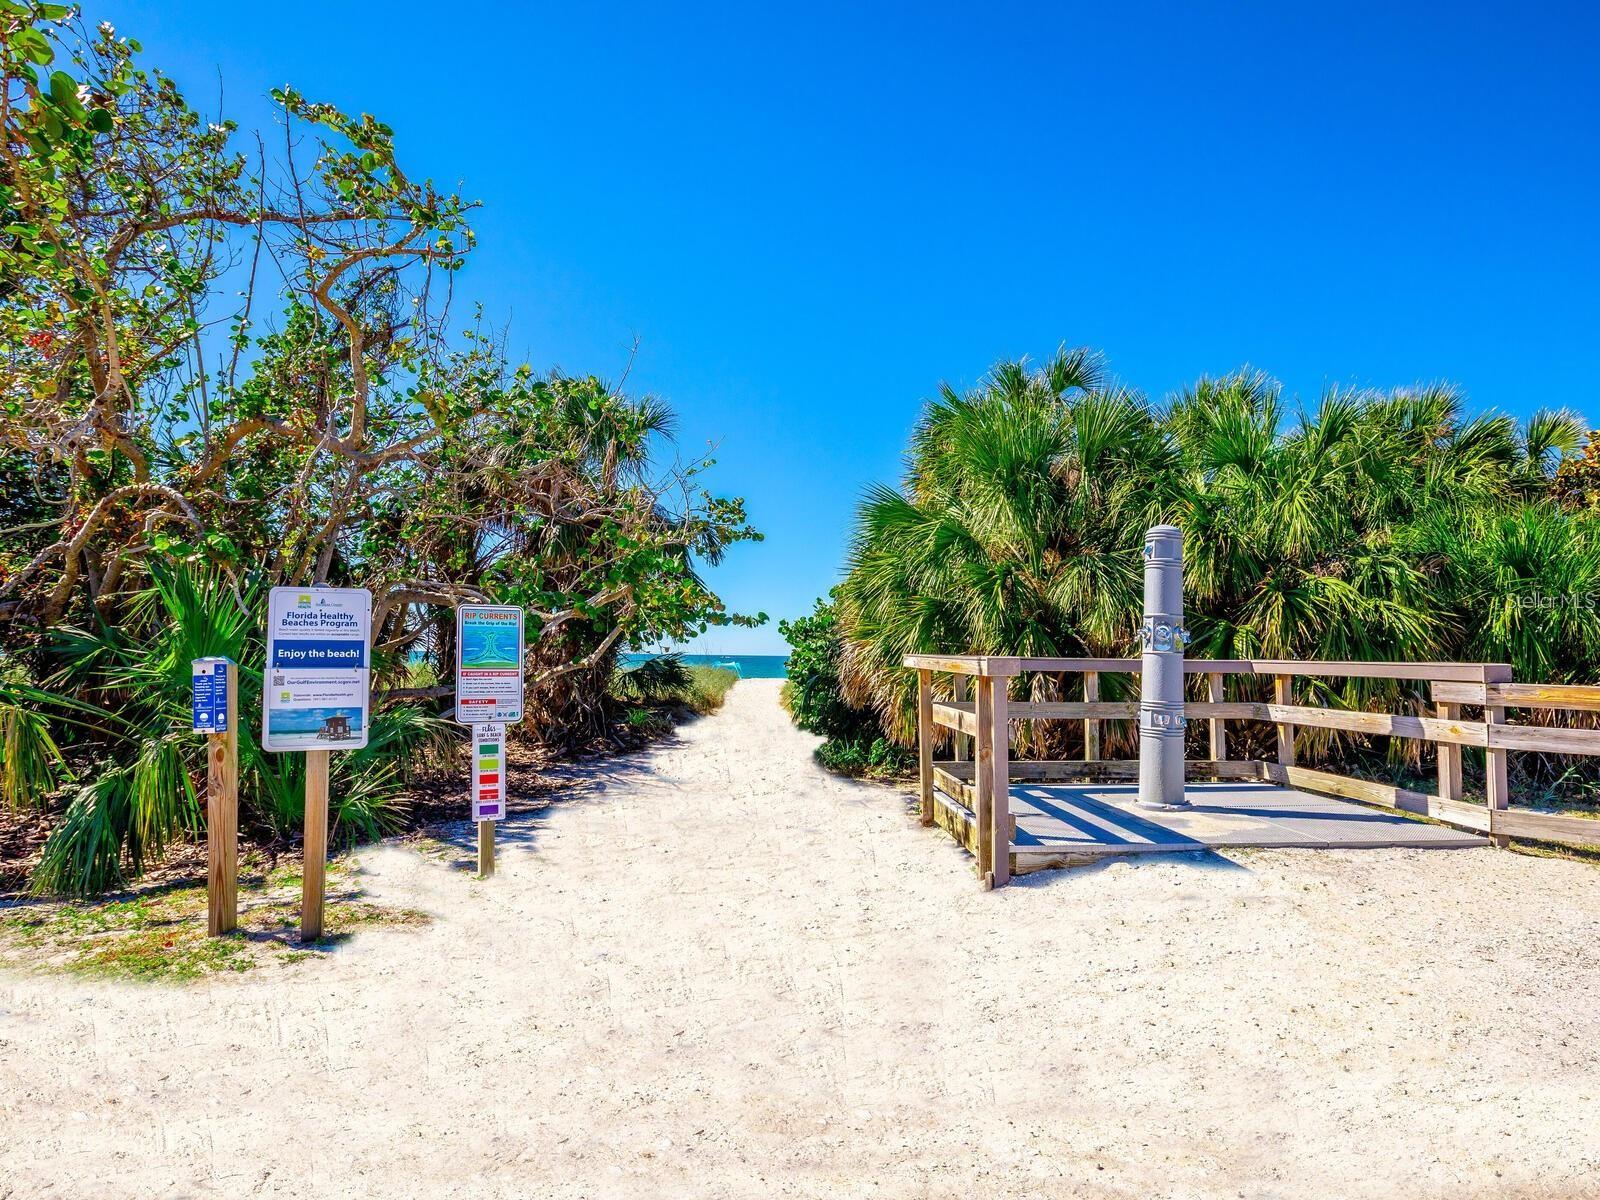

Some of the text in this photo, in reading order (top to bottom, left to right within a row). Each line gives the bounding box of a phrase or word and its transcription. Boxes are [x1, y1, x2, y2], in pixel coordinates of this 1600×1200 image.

[286, 611, 354, 621] Florida Healthy
[479, 612, 518, 620] CURRENTS
[281, 619, 358, 628] Beaches Program
[278, 649, 360, 660] Enjoy the beach!
